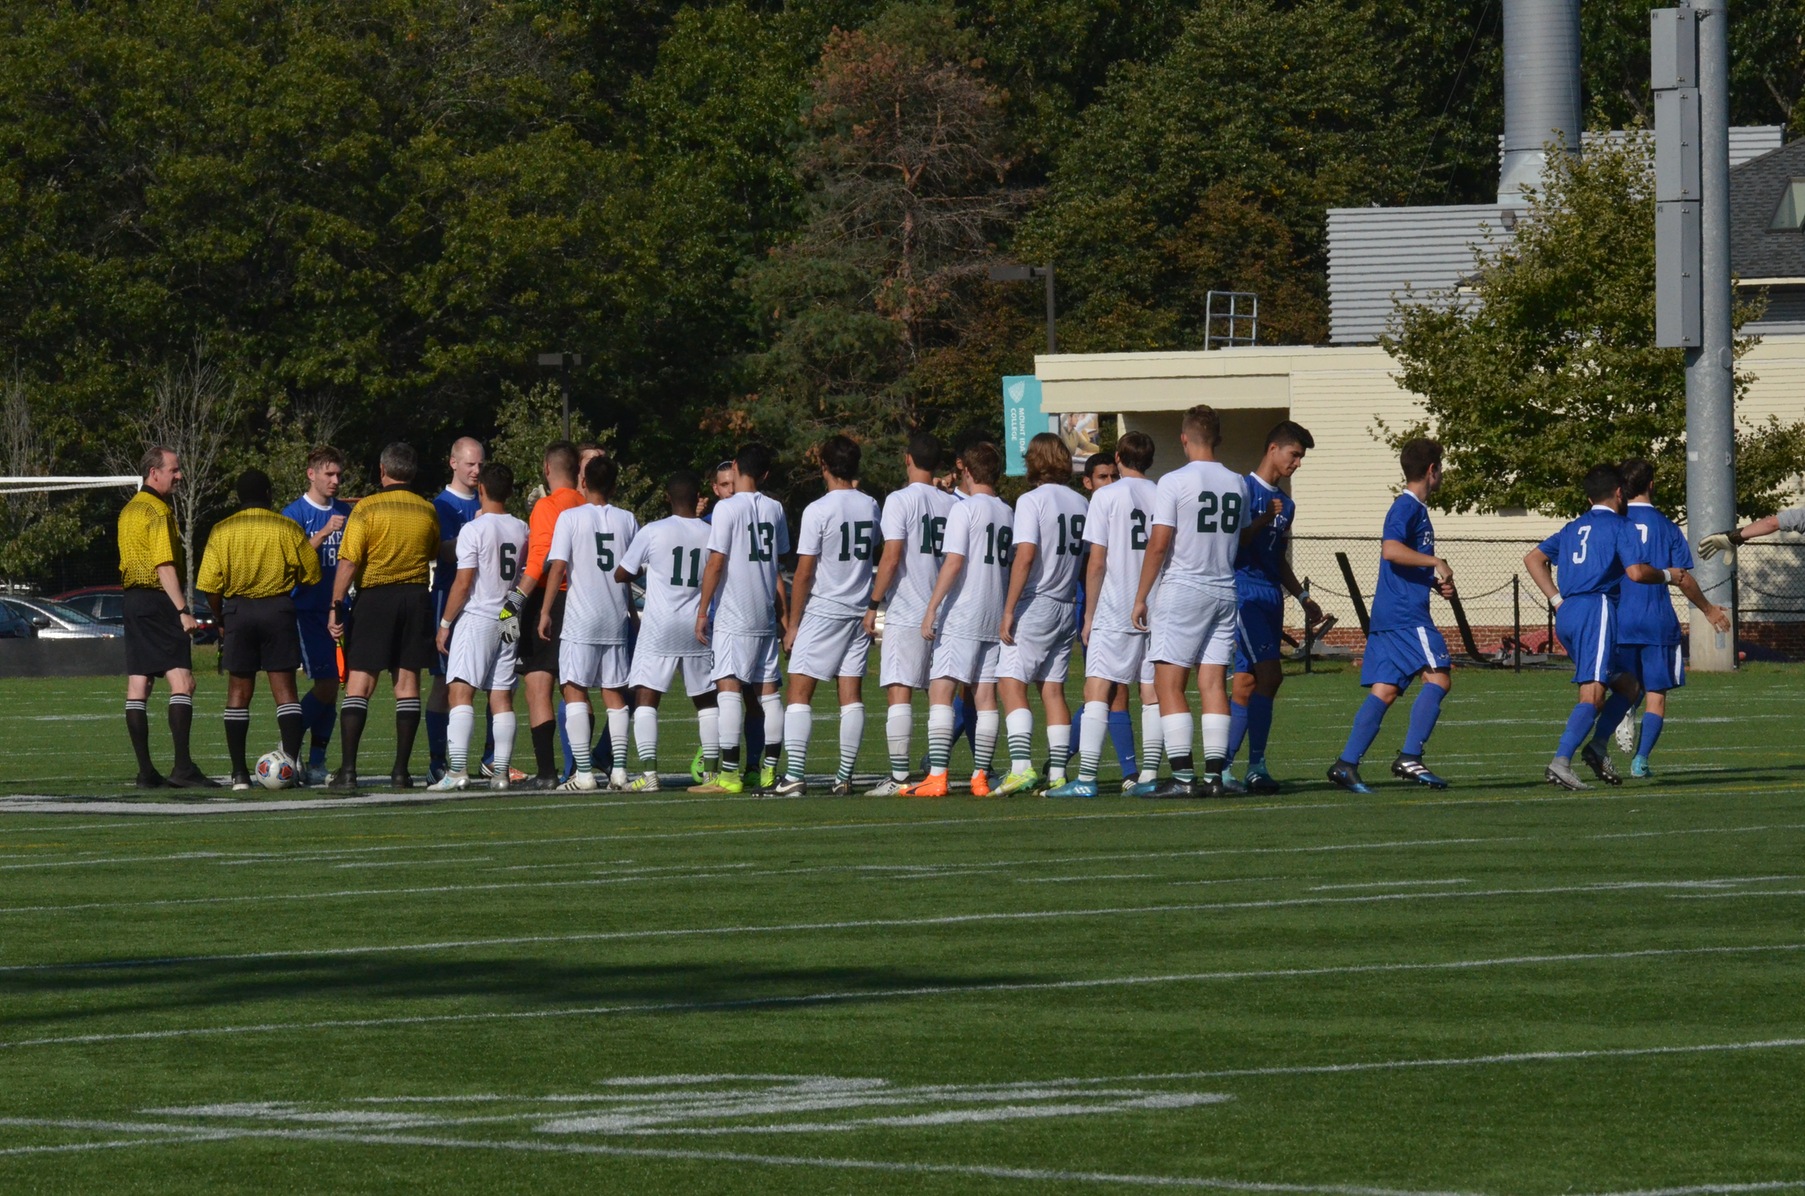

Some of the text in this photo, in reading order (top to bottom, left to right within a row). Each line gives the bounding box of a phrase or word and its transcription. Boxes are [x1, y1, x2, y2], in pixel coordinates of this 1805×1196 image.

[1130, 508, 1154, 550] 2
[1197, 491, 1242, 534] 28
[595, 532, 614, 572] 5
[748, 522, 774, 562] 13
[838, 520, 873, 561] 15
[920, 513, 948, 557] 16
[984, 522, 1013, 567] 18
[1056, 513, 1086, 556] 19
[1572, 525, 1592, 565] 3
[321, 547, 337, 567] 18
[500, 542, 517, 581] 6
[670, 545, 700, 588] 11
